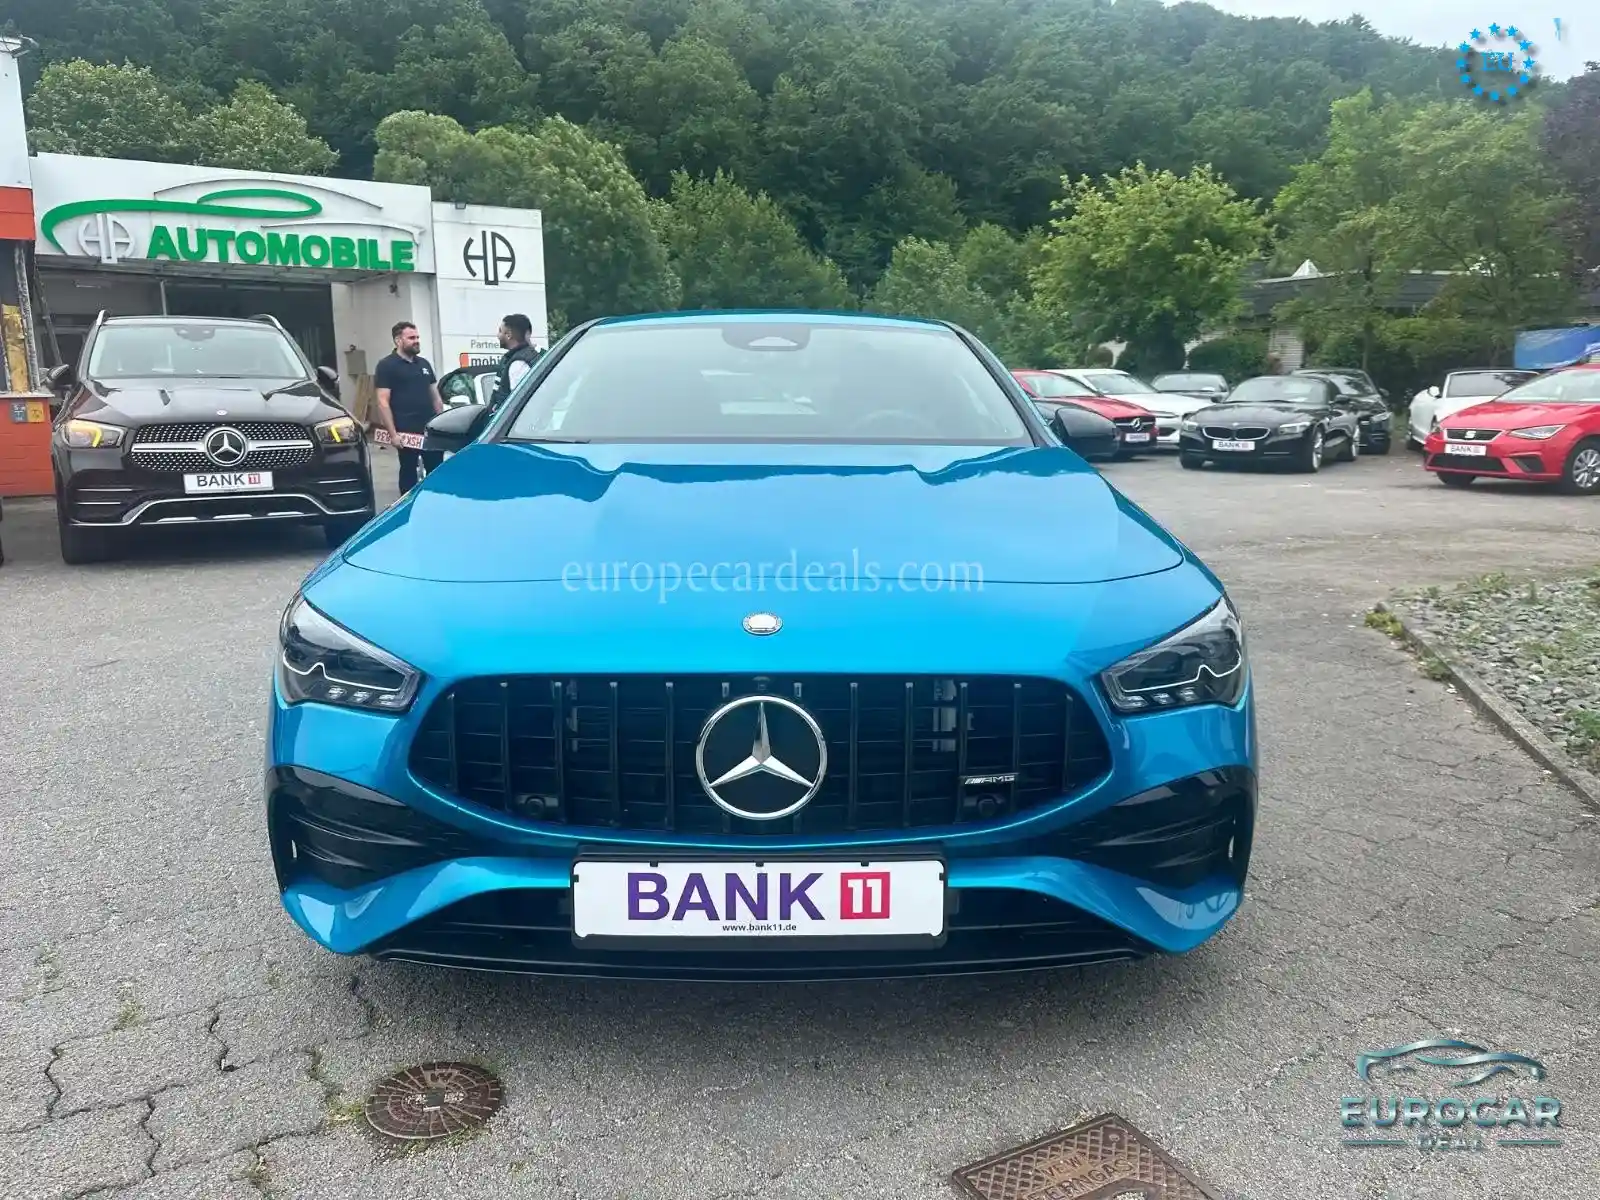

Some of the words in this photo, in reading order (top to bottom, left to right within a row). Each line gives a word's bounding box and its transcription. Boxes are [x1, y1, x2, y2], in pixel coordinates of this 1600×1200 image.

[146, 224, 415, 272] AUTOMOBILE
[470, 339, 499, 349] Partne
[471, 356, 501, 367] mobi
[196, 474, 245, 487] BANK
[627, 872, 826, 921] BANK
[845, 877, 884, 915] 11
[721, 924, 797, 933] www.bank11.de
[1027, 1158, 1136, 1200] ERNGAS
